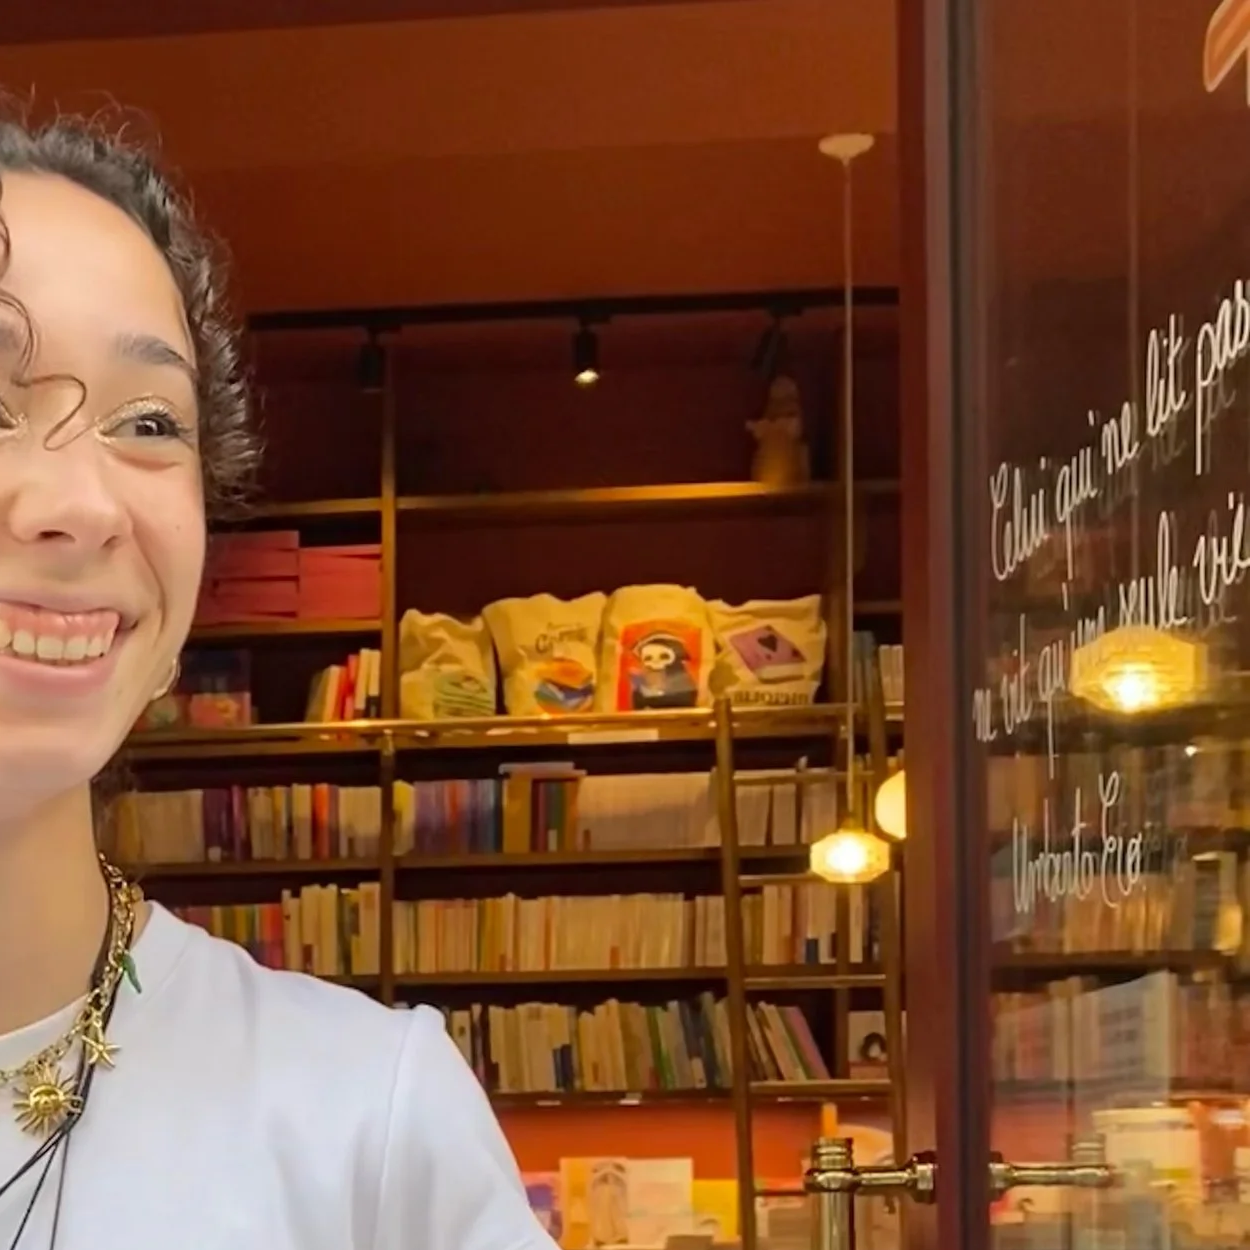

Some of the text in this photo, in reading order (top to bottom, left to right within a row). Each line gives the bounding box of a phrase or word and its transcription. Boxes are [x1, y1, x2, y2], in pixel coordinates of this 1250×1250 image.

[990, 278, 1250, 581] Celui qui ne lit pas
[973, 687, 998, 742] ne
[1001, 612, 1033, 735] vit
[1193, 491, 1250, 605] vie
[1012, 786, 1095, 914] Umberto
